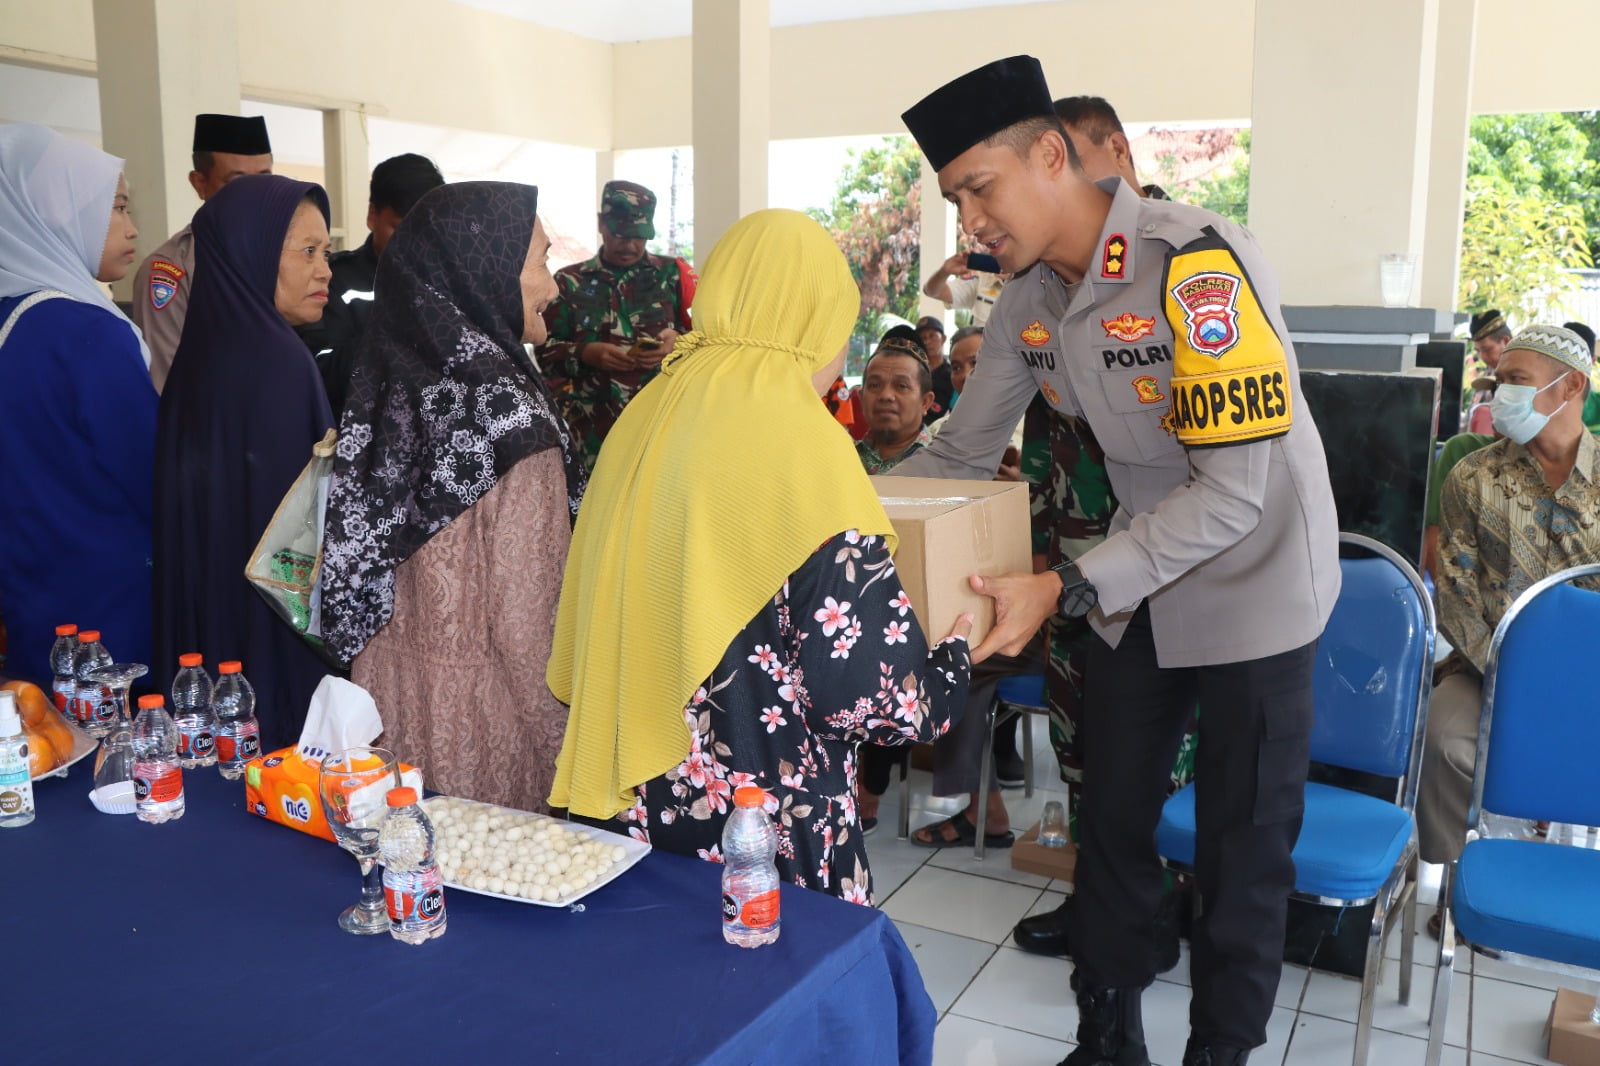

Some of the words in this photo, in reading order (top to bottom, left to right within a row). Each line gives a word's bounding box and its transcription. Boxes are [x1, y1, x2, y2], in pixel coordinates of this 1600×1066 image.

[1182, 279, 1232, 293] POLRES
[1184, 284, 1231, 298] PASURUAN
[1102, 344, 1173, 369] POLRI
